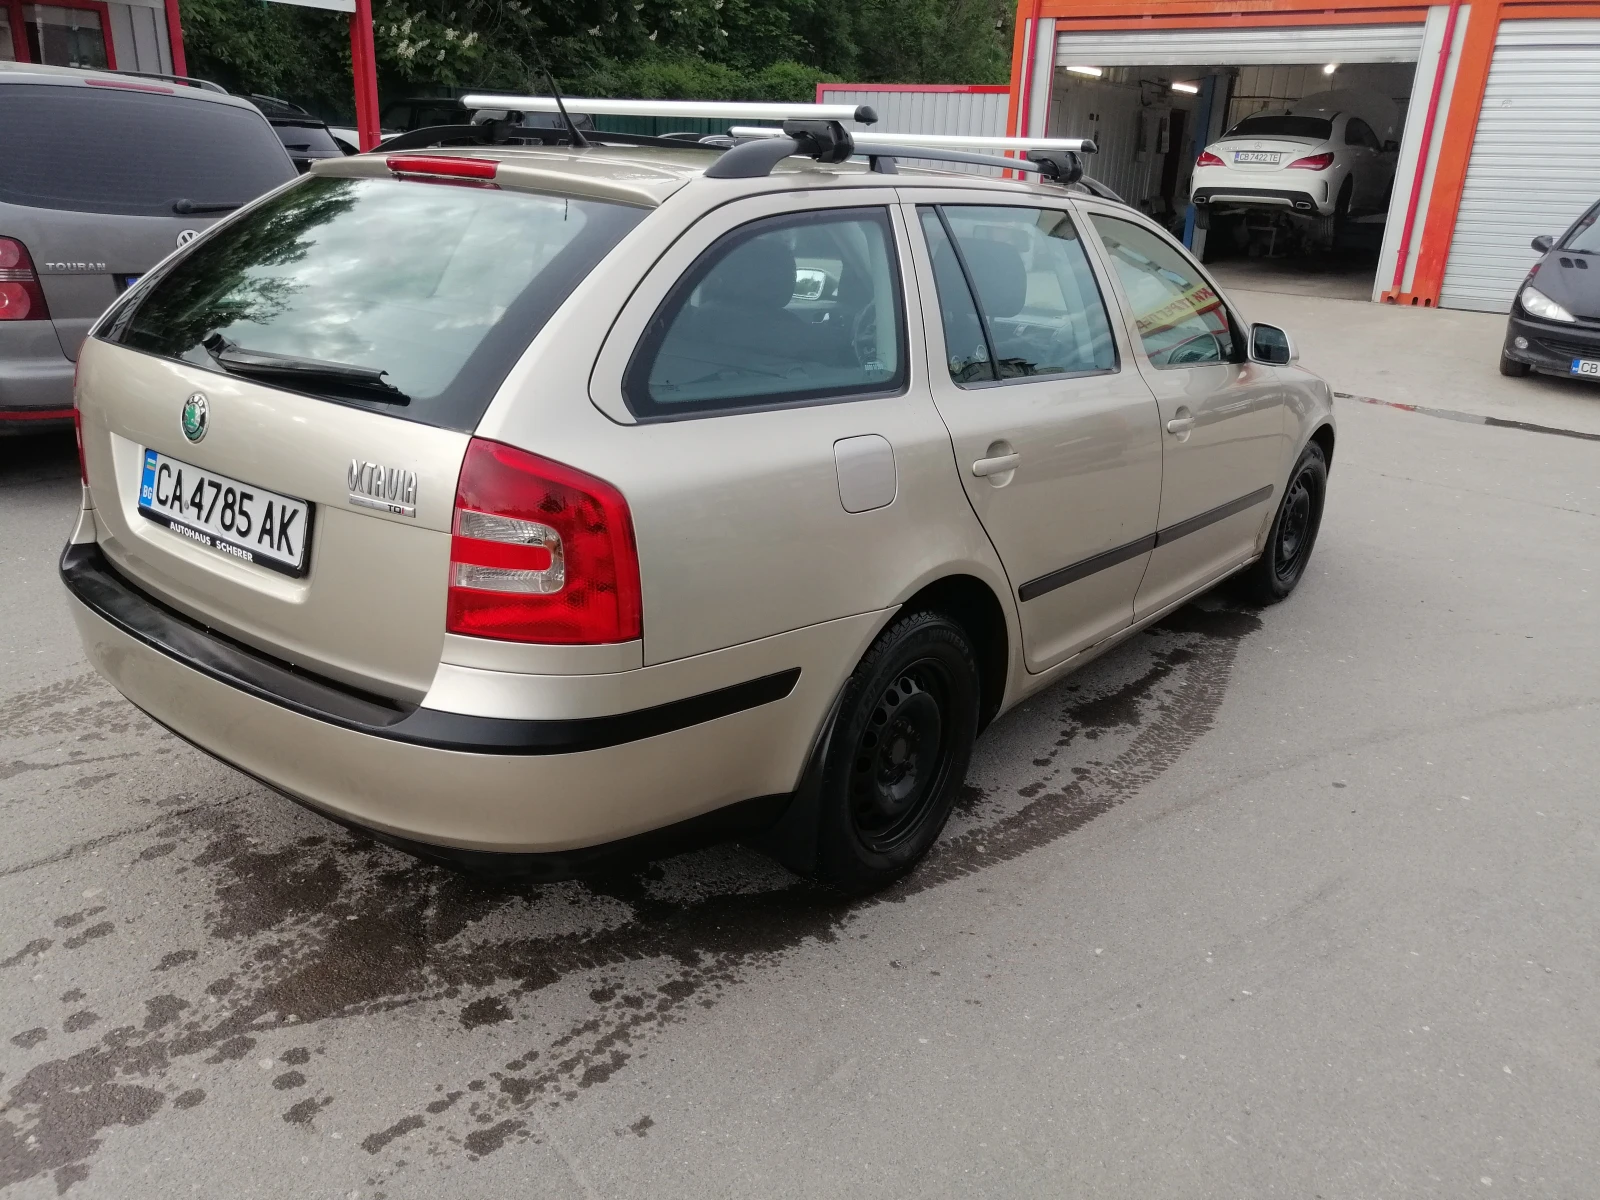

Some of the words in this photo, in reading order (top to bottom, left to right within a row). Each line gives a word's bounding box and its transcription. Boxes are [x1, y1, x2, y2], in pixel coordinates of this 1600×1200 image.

[1240, 153, 1250, 161] CB
[1250, 153, 1268, 162] 7422
[1269, 154, 1279, 162] TE
[45, 262, 106, 271] TOURAN
[1581, 362, 1598, 374] CB
[348, 459, 417, 505] OCTAVIA
[143, 485, 153, 500] BG
[156, 462, 184, 514] CA
[190, 477, 254, 538] 4785
[257, 500, 300, 556] AK
[170, 521, 211, 546] AUTOHAUS
[215, 540, 254, 563] SCHERER
